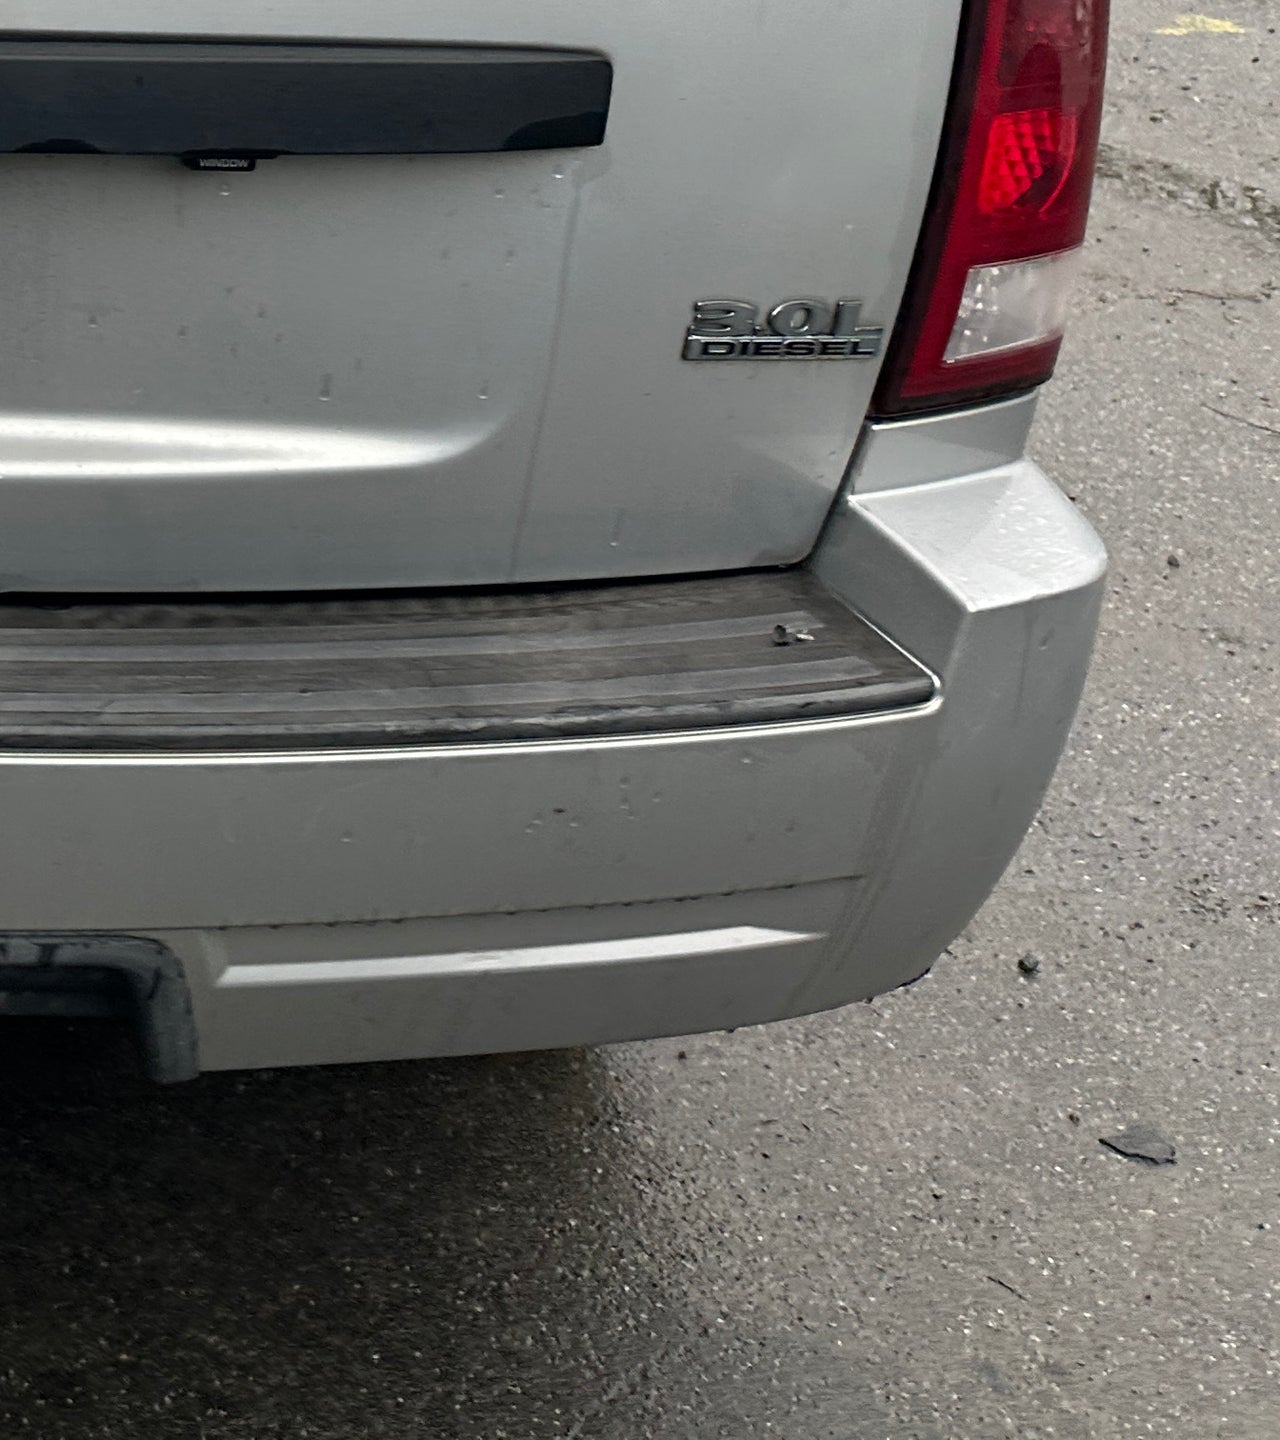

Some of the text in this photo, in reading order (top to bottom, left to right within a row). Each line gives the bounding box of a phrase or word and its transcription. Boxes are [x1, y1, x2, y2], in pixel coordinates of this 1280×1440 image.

[199, 158, 249, 168] WINDOW
[693, 298, 884, 337] 3.0L
[700, 337, 875, 357] DIESEL
